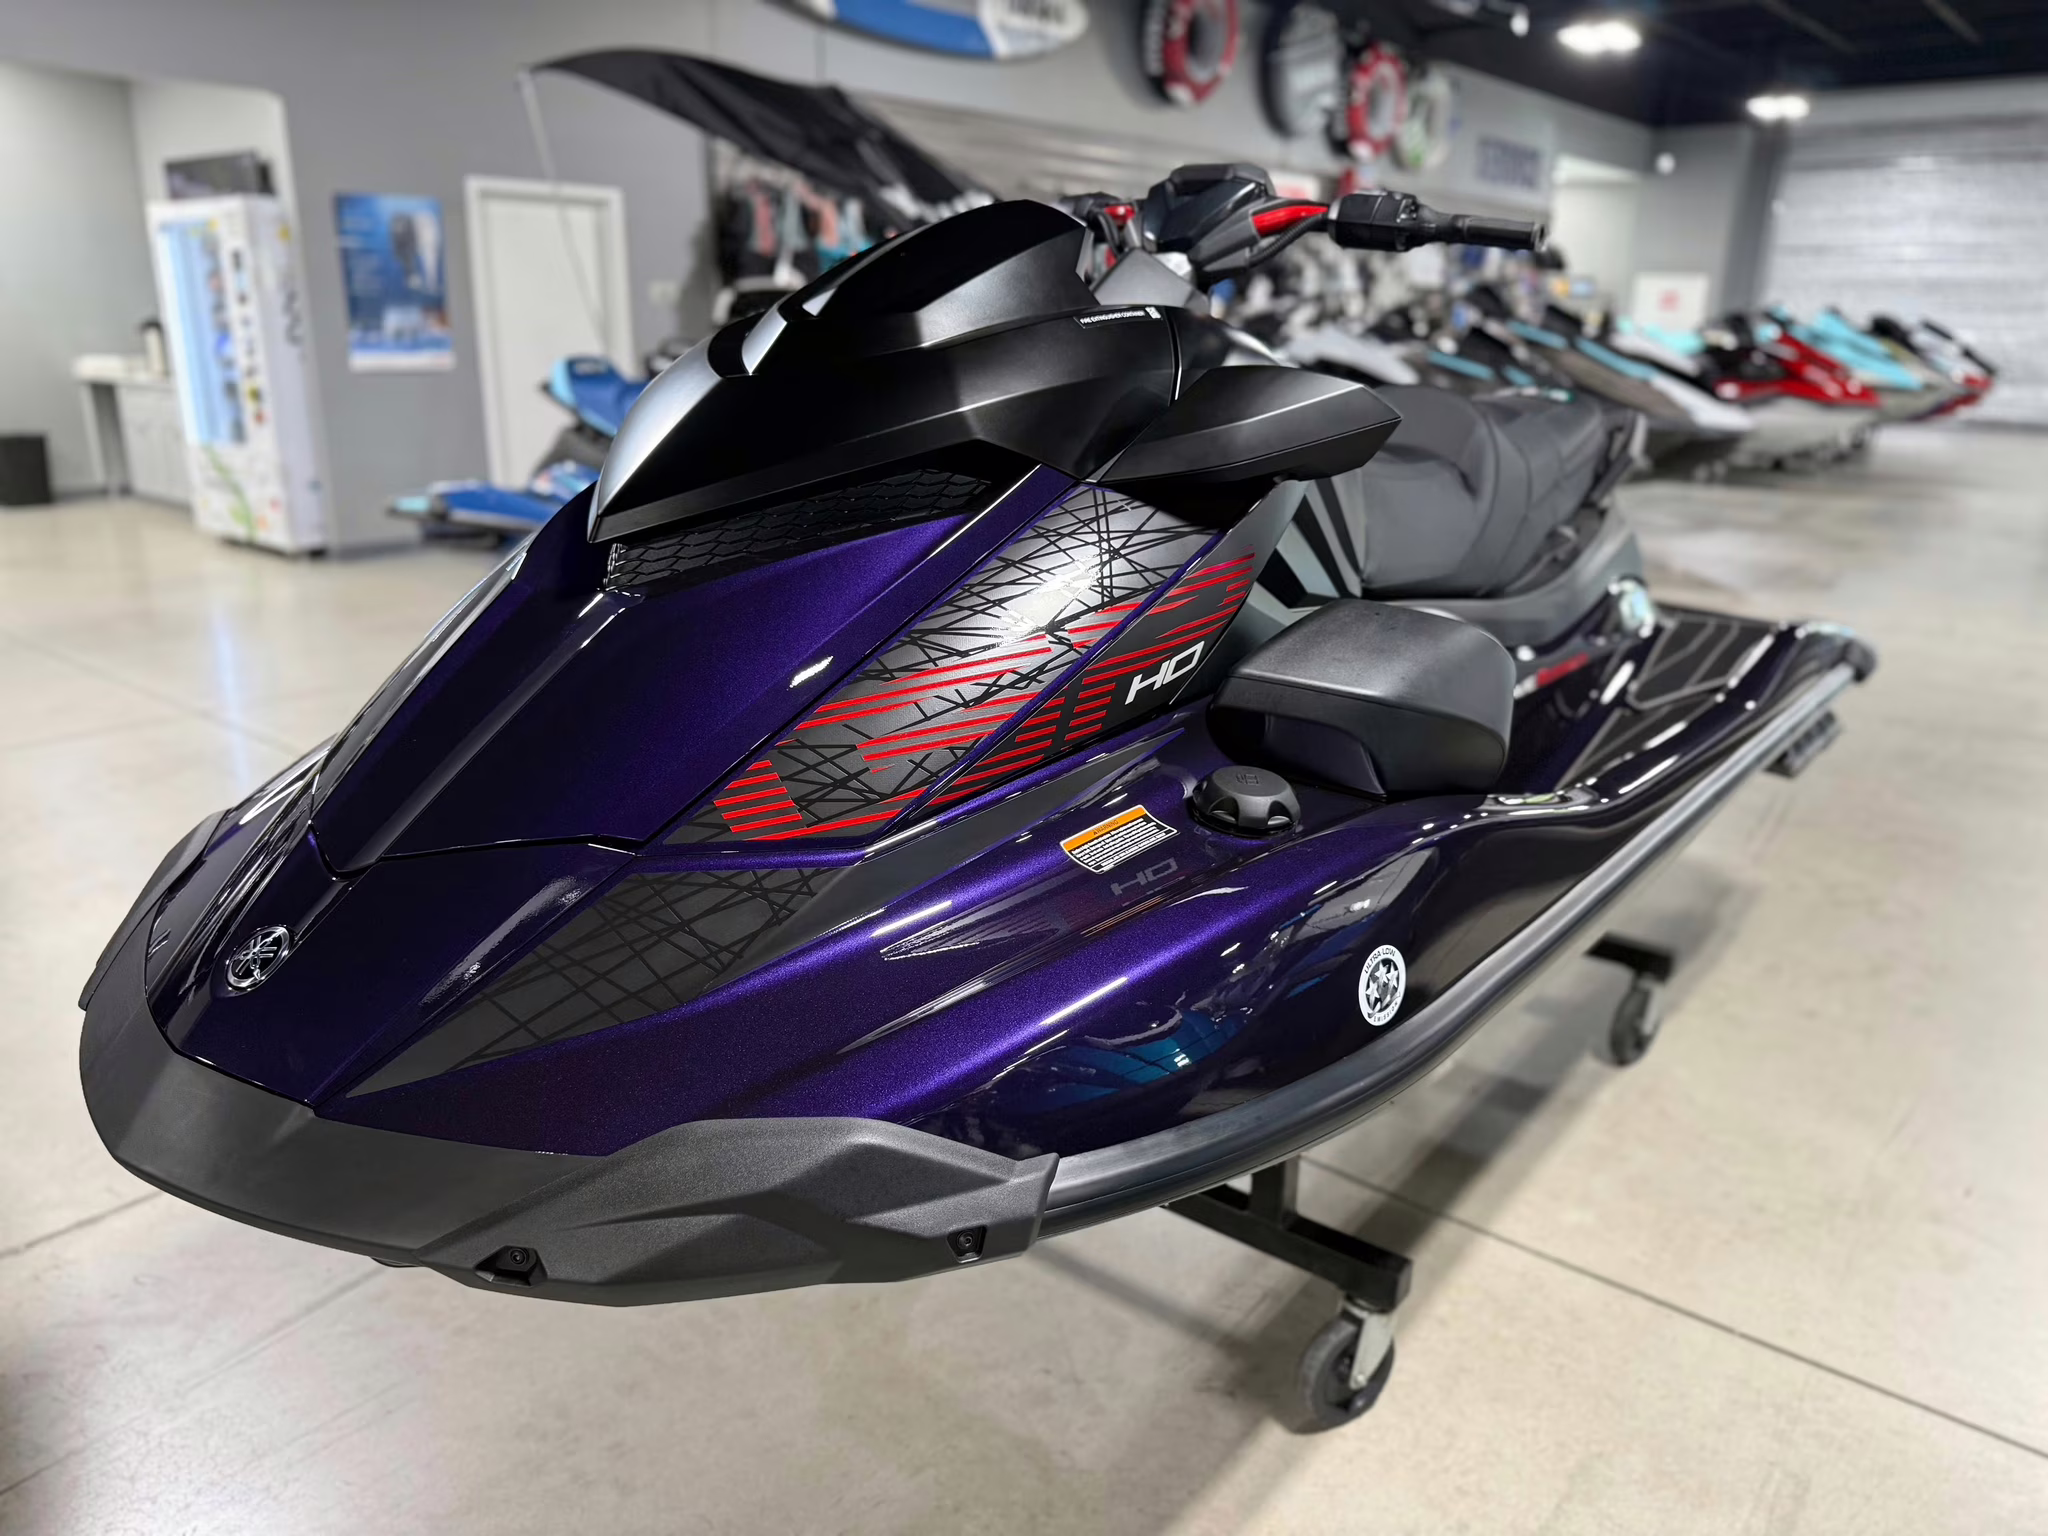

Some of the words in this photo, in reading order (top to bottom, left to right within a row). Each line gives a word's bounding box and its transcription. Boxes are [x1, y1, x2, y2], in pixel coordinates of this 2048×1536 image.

[1364, 950, 1381, 974] ULTRA
[1382, 947, 1396, 957] LOW
[1373, 1001, 1399, 1023] EMISSION
